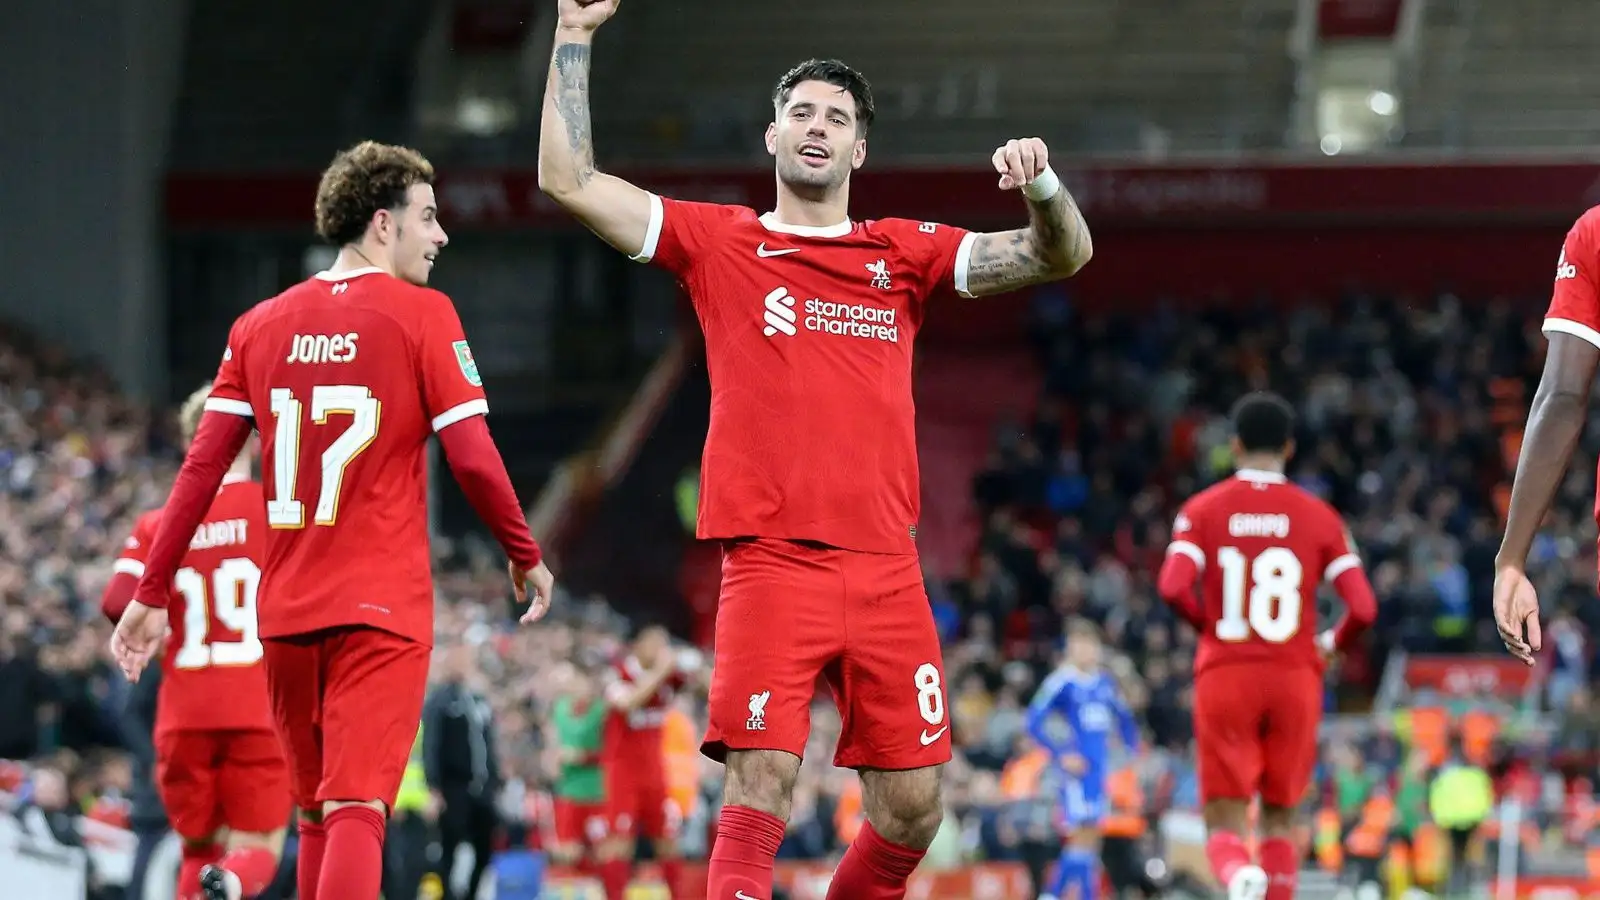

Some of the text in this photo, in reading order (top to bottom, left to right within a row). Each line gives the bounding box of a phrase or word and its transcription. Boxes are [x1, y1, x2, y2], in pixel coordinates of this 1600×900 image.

[804, 298, 896, 325] standard
[804, 315, 898, 342] chartered
[287, 333, 359, 363] JONES
[268, 385, 381, 529] 17
[174, 557, 263, 669] 19
[1215, 546, 1303, 643] 18
[914, 662, 944, 725] 8
